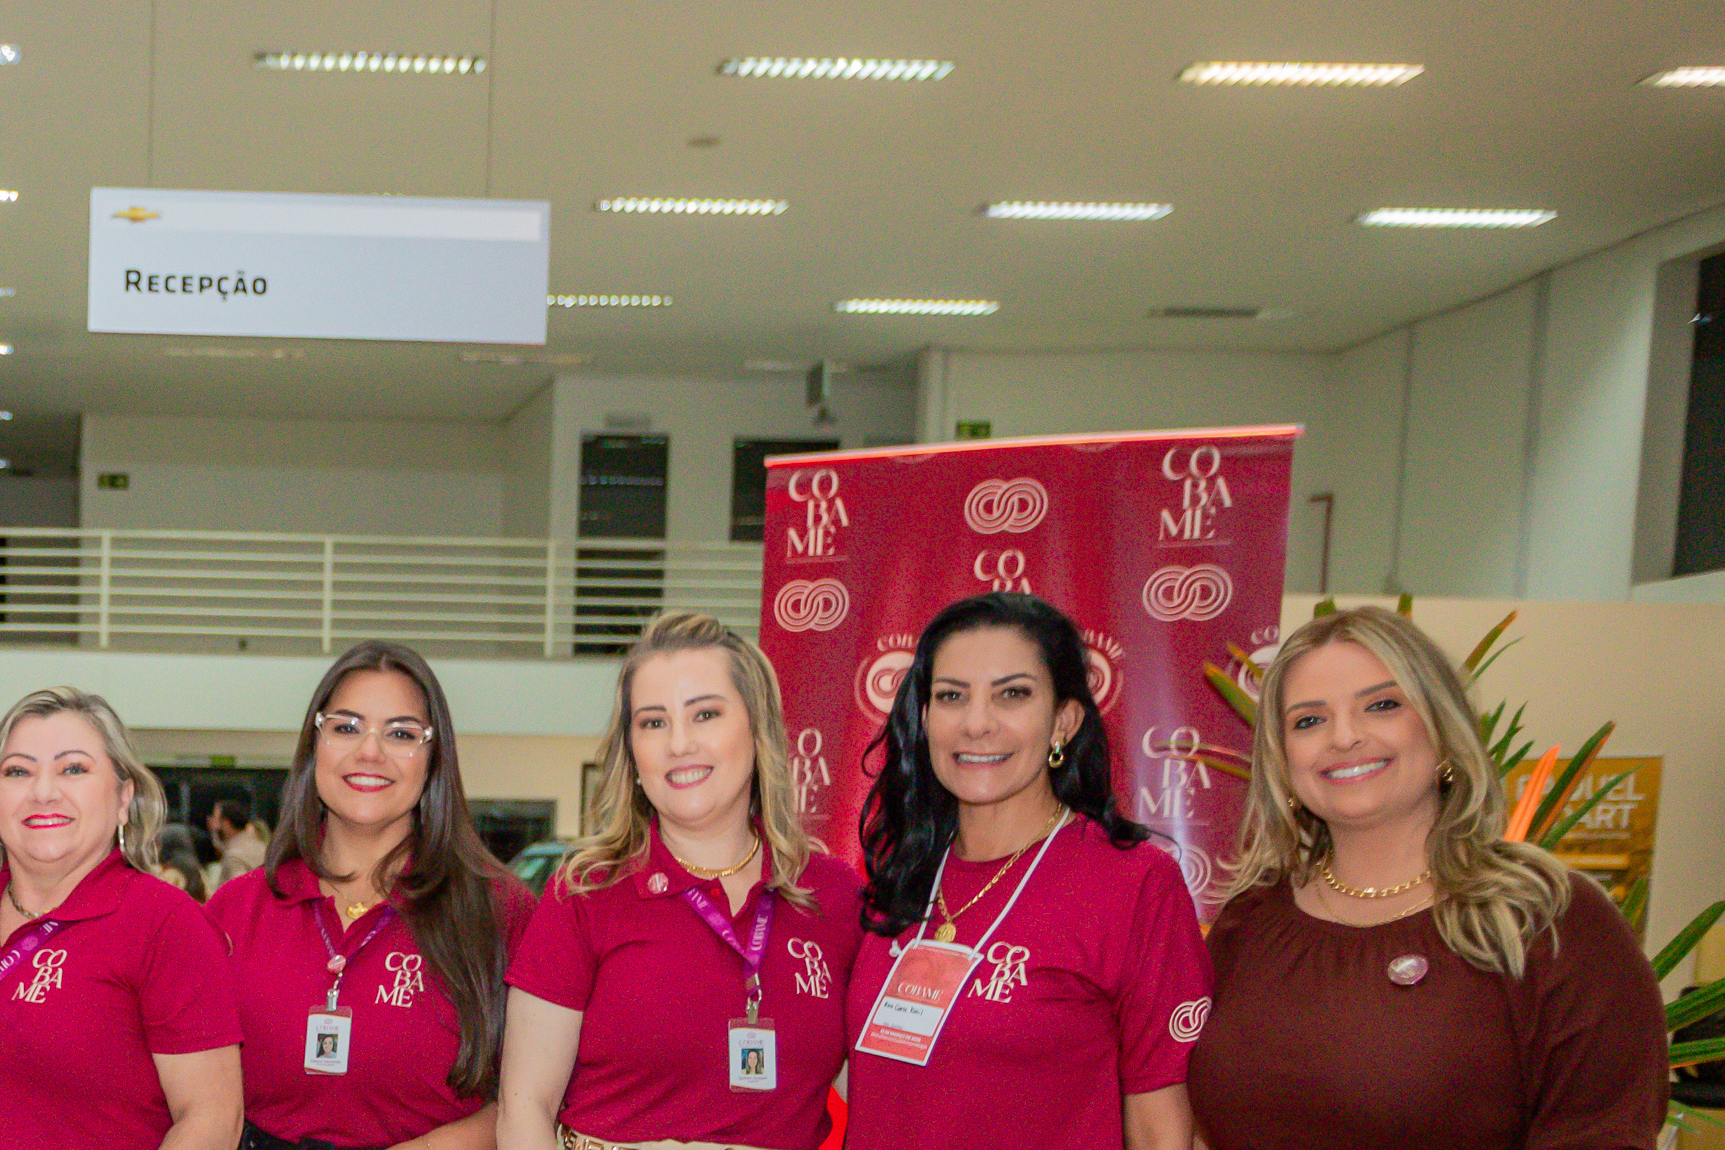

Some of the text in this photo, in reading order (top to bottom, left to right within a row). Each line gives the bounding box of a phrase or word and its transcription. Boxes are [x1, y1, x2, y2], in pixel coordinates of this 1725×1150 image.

[124, 268, 269, 301] RECEPÇÃO
[1160, 444, 1222, 481] CO
[787, 467, 840, 502] CO
[1182, 475, 1233, 511] BA
[806, 496, 850, 530] BA
[1157, 505, 1218, 542] ME
[786, 525, 837, 558] ME
[972, 548, 1027, 582] CO
[1141, 725, 1201, 759] CO
[793, 756, 831, 786] BA
[1161, 757, 1212, 790] BA
[1139, 785, 1196, 819] ME
[31, 948, 68, 969] CO
[384, 950, 422, 972] CO
[787, 936, 823, 962] CO
[986, 940, 1031, 965] CO
[31, 966, 64, 990] BA
[393, 970, 425, 992] BA
[804, 956, 833, 985] BA
[990, 961, 1029, 987] BA
[10, 981, 51, 1005] ME
[374, 984, 415, 1009] ME
[794, 972, 830, 1000] ME
[966, 977, 1016, 1004] ME
